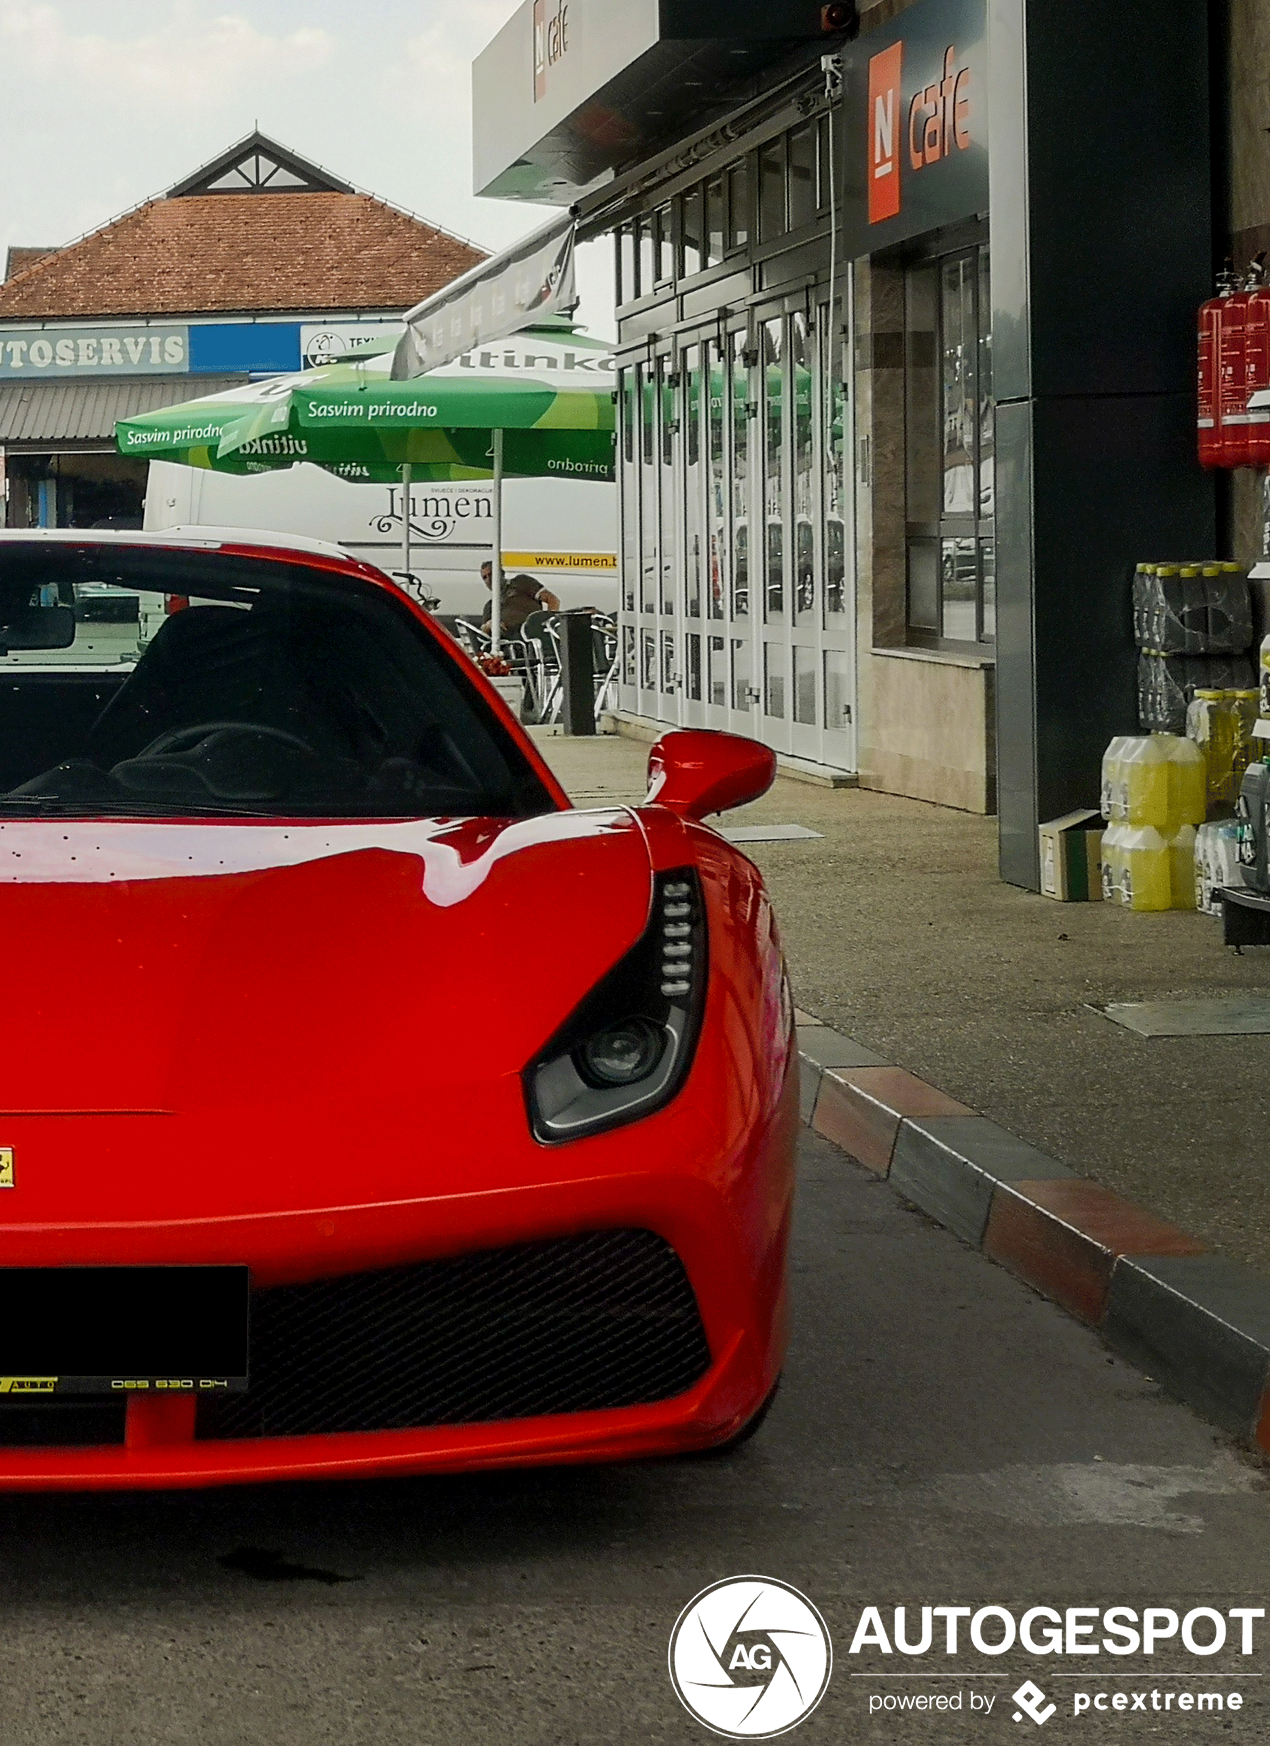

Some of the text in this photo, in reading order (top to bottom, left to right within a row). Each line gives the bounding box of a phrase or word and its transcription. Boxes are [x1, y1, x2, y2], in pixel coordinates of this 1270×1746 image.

[874, 44, 970, 171] N cafe
[308, 400, 437, 421] Sasvim prirodno
[127, 428, 170, 445] Sasvim
